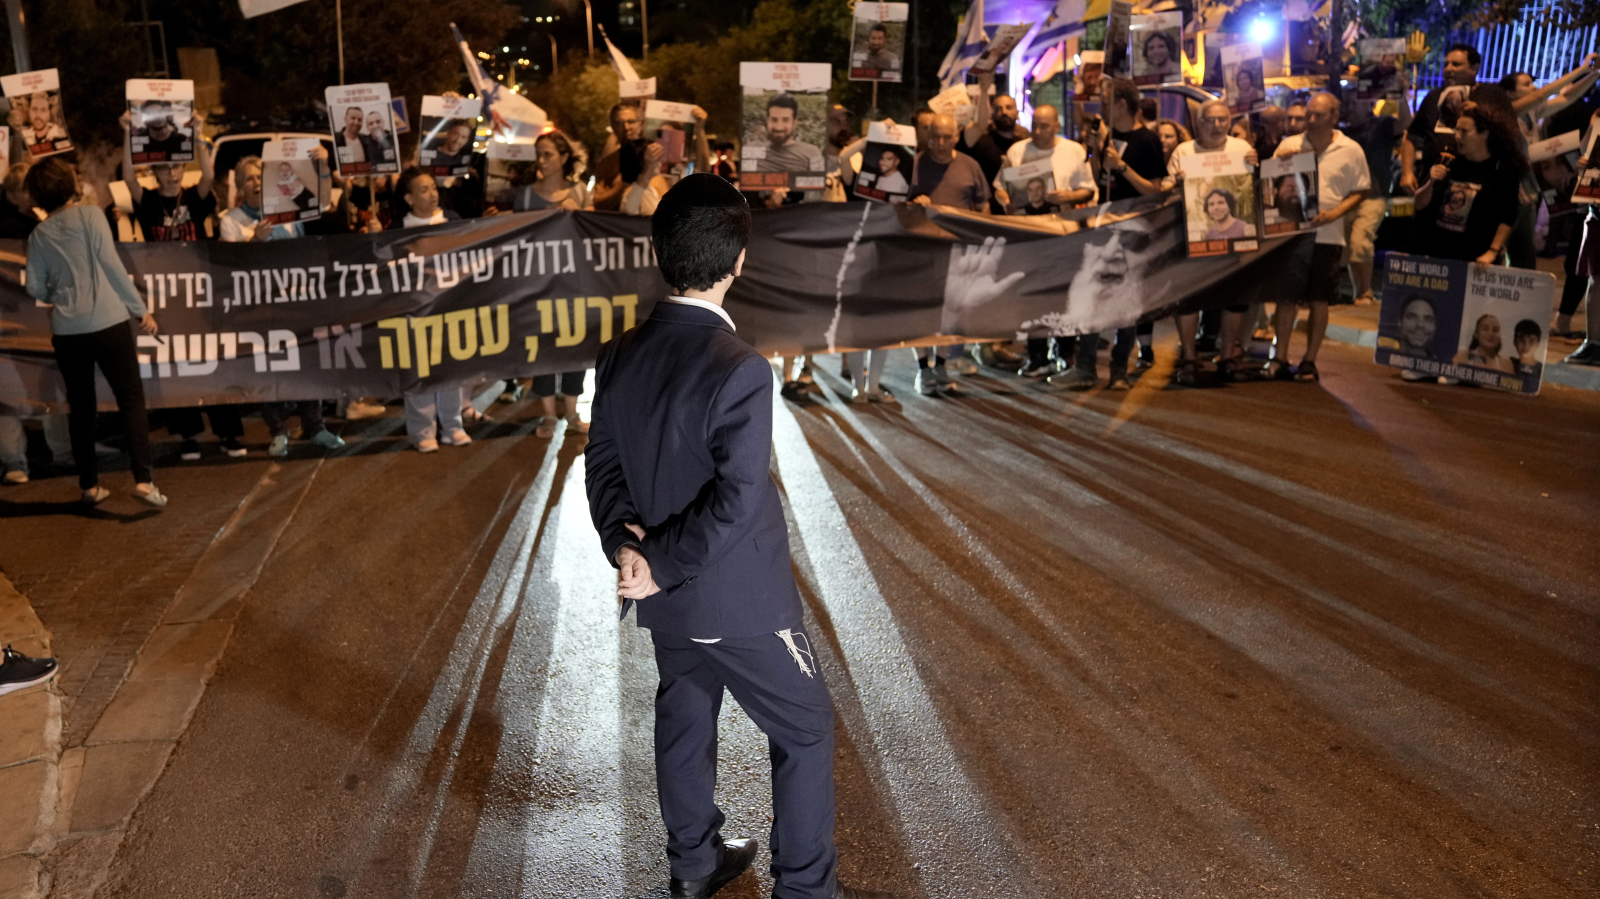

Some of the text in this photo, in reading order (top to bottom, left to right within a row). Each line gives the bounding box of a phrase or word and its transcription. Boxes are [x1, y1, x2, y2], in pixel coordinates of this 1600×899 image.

[387, 251, 426, 294] לנו
[433, 247, 494, 289] שיש
[502, 239, 576, 279] גדולה
[583, 237, 625, 272] הכי
[1389, 259, 1449, 276] TO THE WORLD
[144, 272, 214, 314] פדיון
[222, 265, 327, 313] המצוות,
[333, 261, 383, 298] בכל
[1388, 272, 1449, 291] YOU ARE A DAD
[1471, 284, 1521, 302] THE WORLD
[1484, 272, 1496, 284] US
[1498, 274, 1516, 288] YOU
[1517, 276, 1535, 290] ARE
[136, 294, 640, 380] דרעי, עסקה או פרישה
[1389, 354, 1524, 392] BRING THEIR FATHER HOME NOW!
